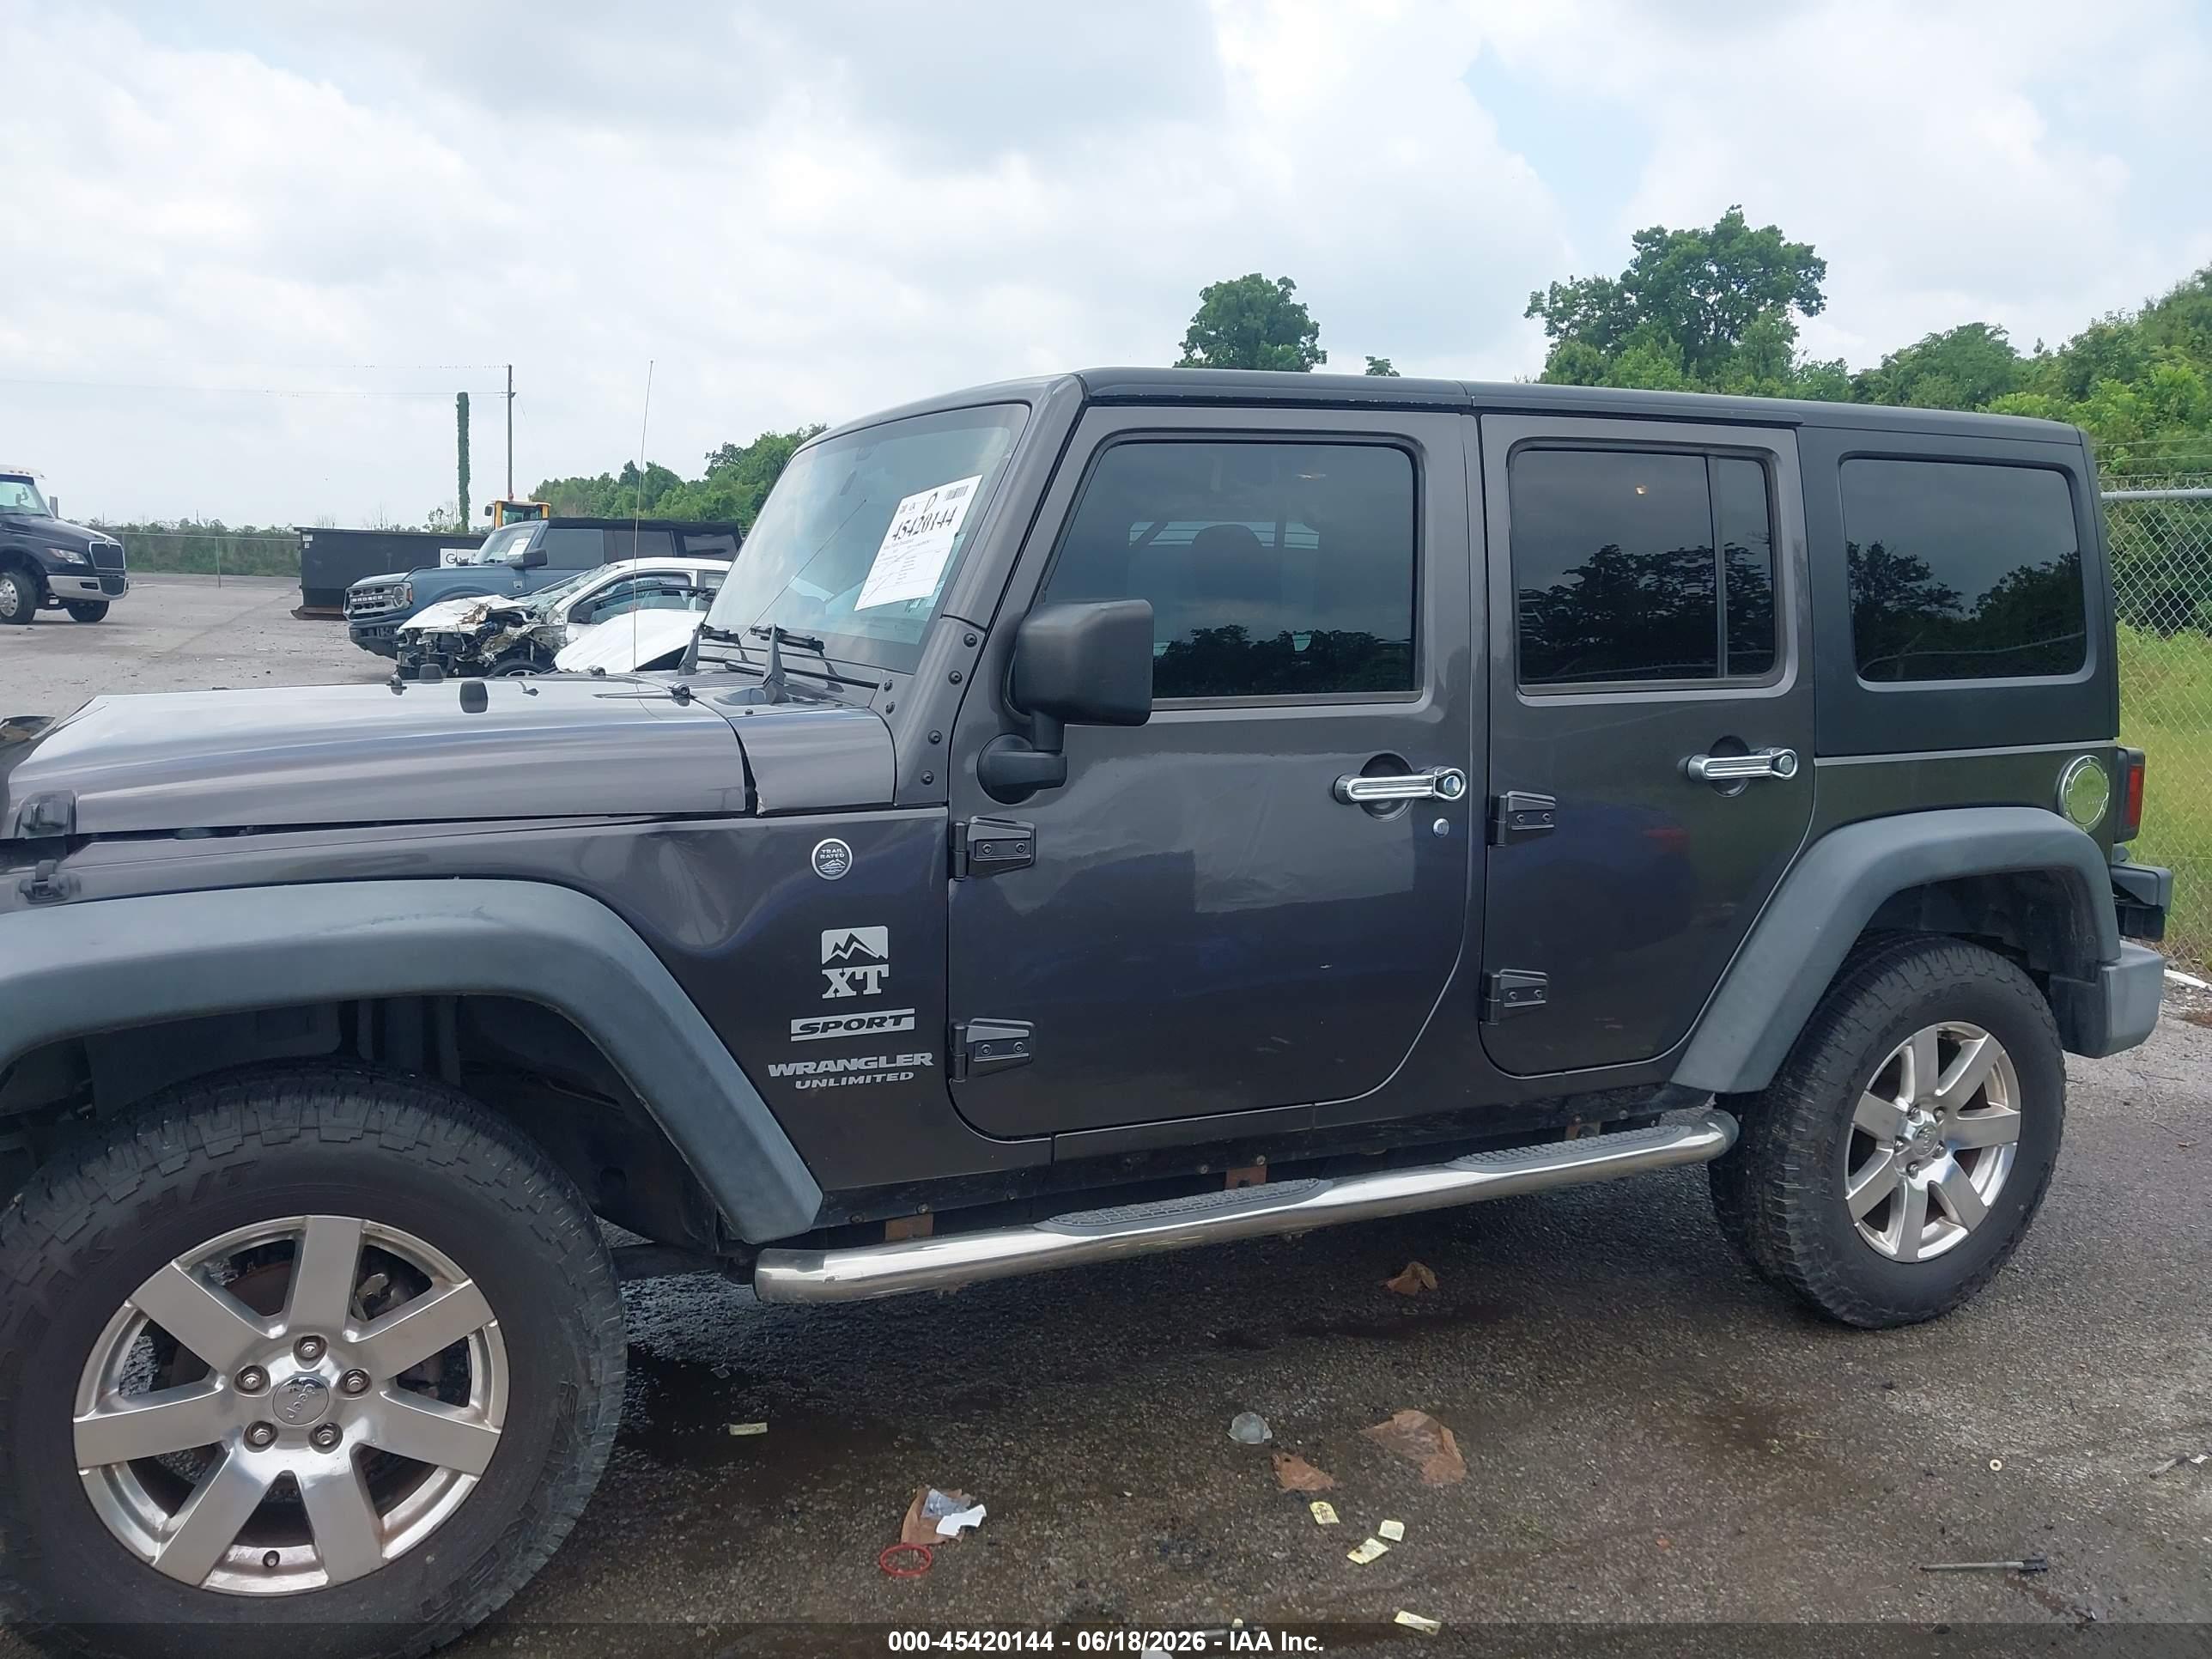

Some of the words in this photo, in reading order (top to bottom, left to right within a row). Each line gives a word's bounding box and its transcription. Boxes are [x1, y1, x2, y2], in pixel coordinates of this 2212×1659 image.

[892, 506, 958, 541] 45420144
[822, 963, 890, 1000] XT
[792, 1014, 914, 1036] SPORT
[768, 1052, 935, 1077] WRANGLER
[795, 1072, 915, 1090] UNLIMITED
